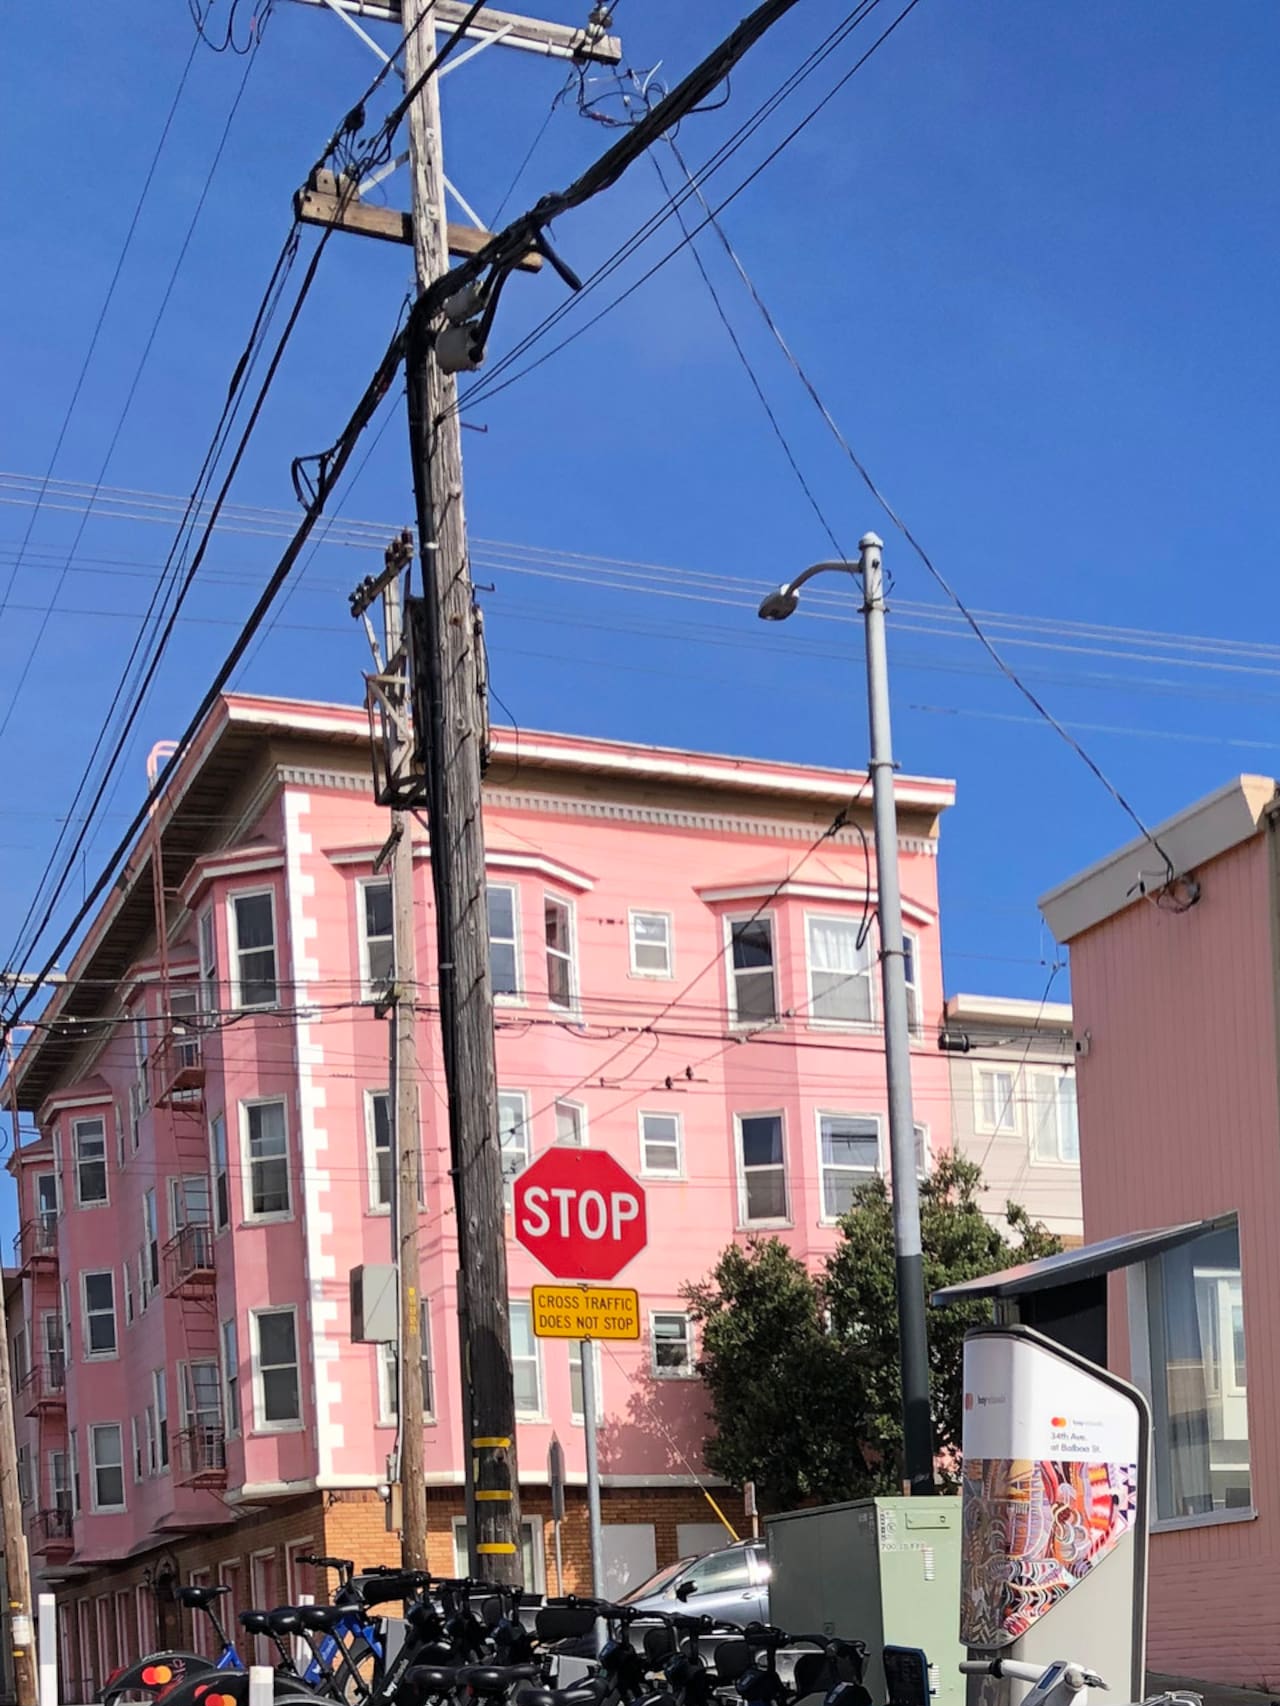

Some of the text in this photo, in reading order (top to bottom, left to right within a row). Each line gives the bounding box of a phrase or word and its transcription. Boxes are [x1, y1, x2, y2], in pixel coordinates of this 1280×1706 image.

[522, 1186, 639, 1240] STOP
[538, 1295, 633, 1311] CROSS TRAFFIC
[539, 1314, 633, 1330] DOES NOT STOP
